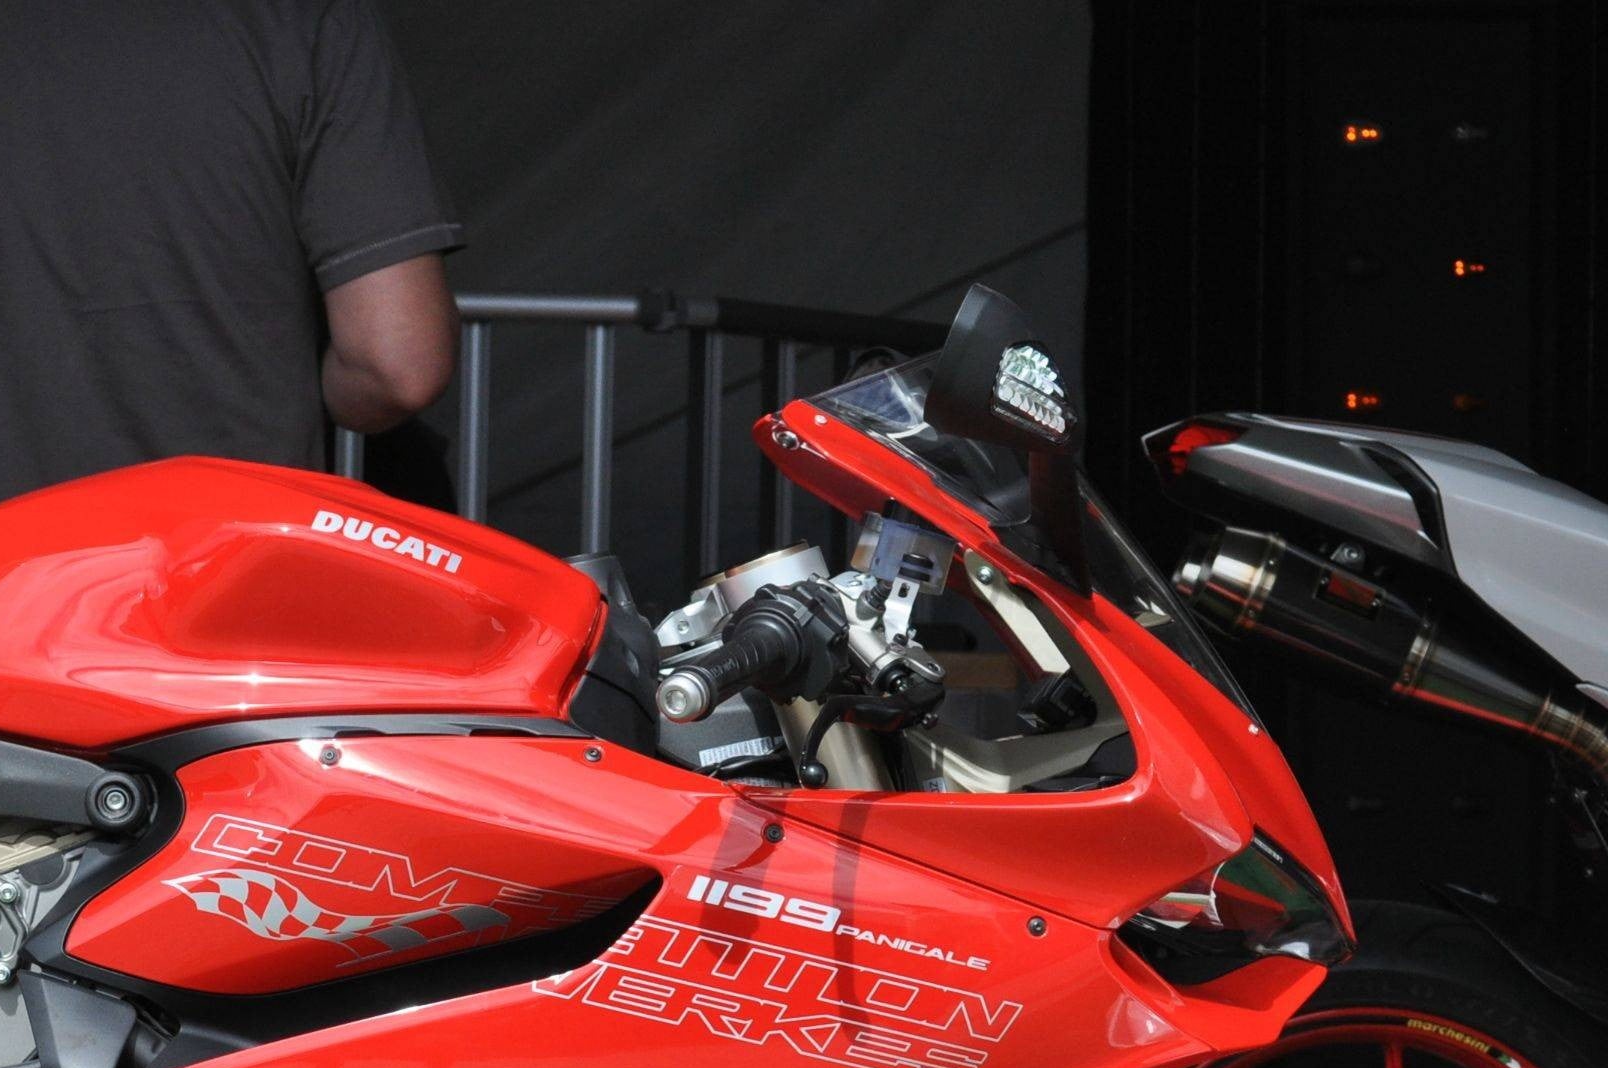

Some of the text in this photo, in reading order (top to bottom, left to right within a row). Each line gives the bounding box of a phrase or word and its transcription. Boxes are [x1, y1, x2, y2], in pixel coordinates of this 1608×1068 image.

[311, 510, 463, 574] DUCATI
[687, 875, 991, 971] 1199 PANIGALE
[1407, 1019, 1490, 1052] marchesini
